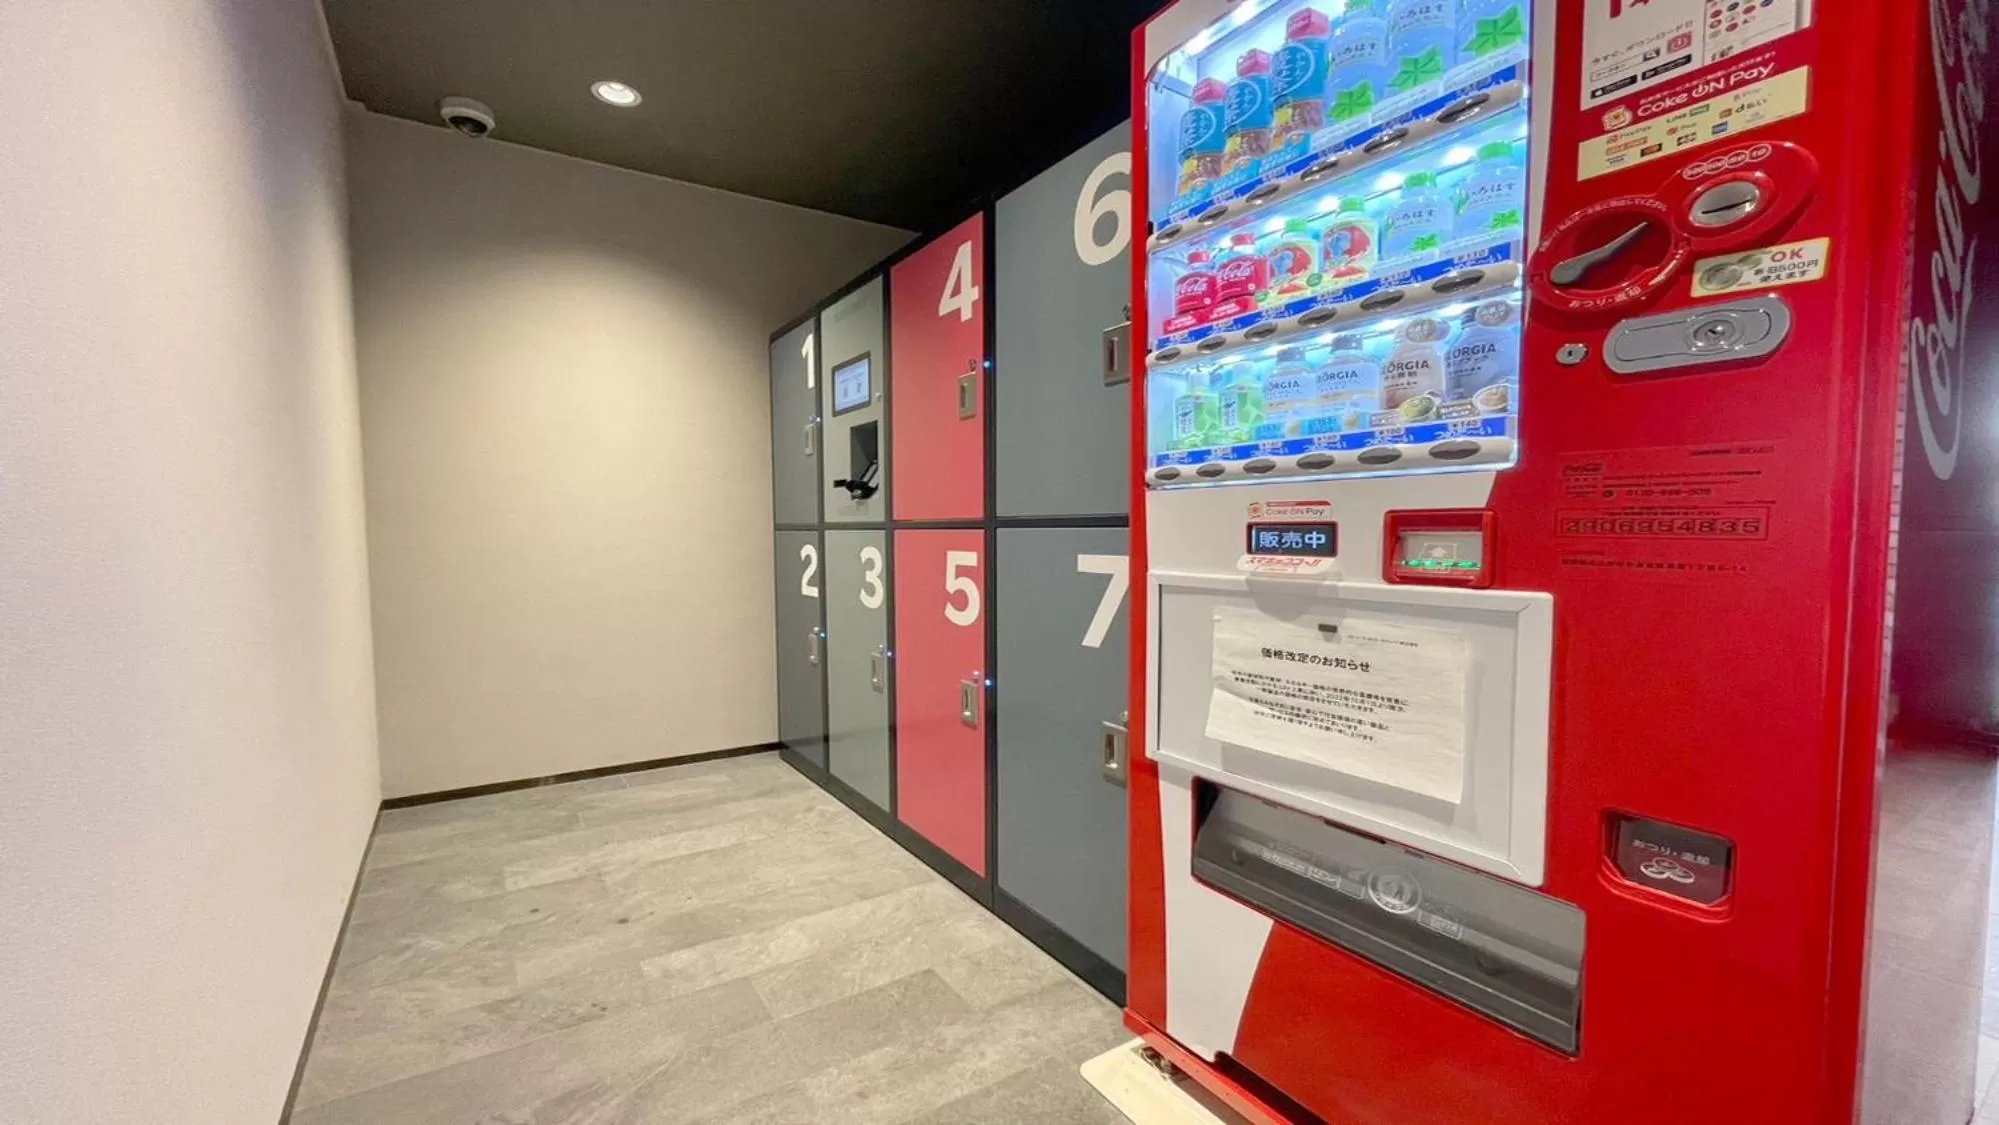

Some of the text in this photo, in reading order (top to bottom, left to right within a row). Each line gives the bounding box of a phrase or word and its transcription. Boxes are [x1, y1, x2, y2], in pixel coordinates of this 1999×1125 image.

[1637, 94, 1689, 118] Coke
[1730, 62, 1776, 86] Pay
[1074, 151, 1132, 266] 6
[937, 240, 980, 322] 4
[1770, 247, 1805, 263] OK
[800, 334, 815, 389] 1
[1306, 507, 1325, 516] Pay
[1259, 530, 1326, 549] 販売中
[800, 543, 819, 598] 2
[859, 546, 884, 610] 3
[944, 551, 981, 626] 5
[1076, 554, 1130, 648] 7
[1261, 647, 1371, 673] 価格改定のお知らせ
